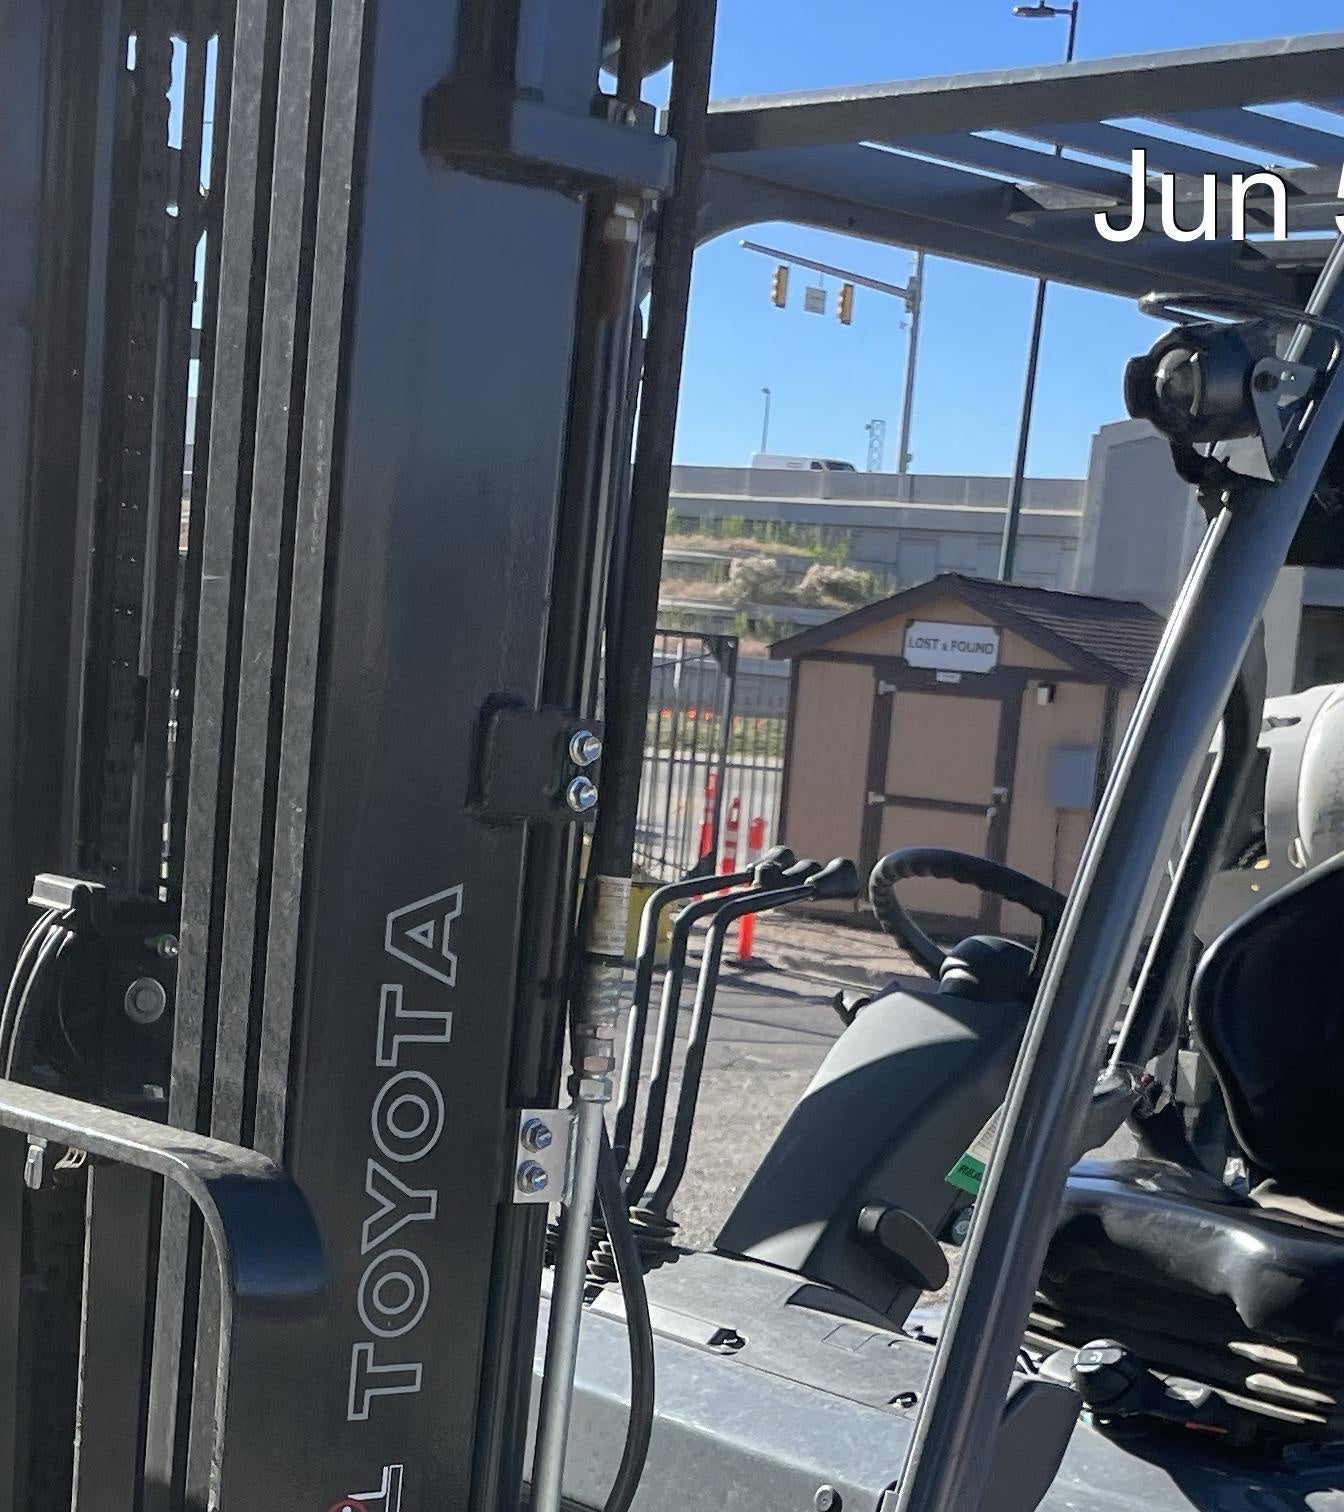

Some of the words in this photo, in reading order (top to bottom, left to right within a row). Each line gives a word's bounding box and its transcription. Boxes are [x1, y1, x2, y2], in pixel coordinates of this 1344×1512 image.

[908, 638, 939, 650] LOST
[951, 641, 994, 655] FOUND
[347, 883, 463, 1421] TOYOTA
